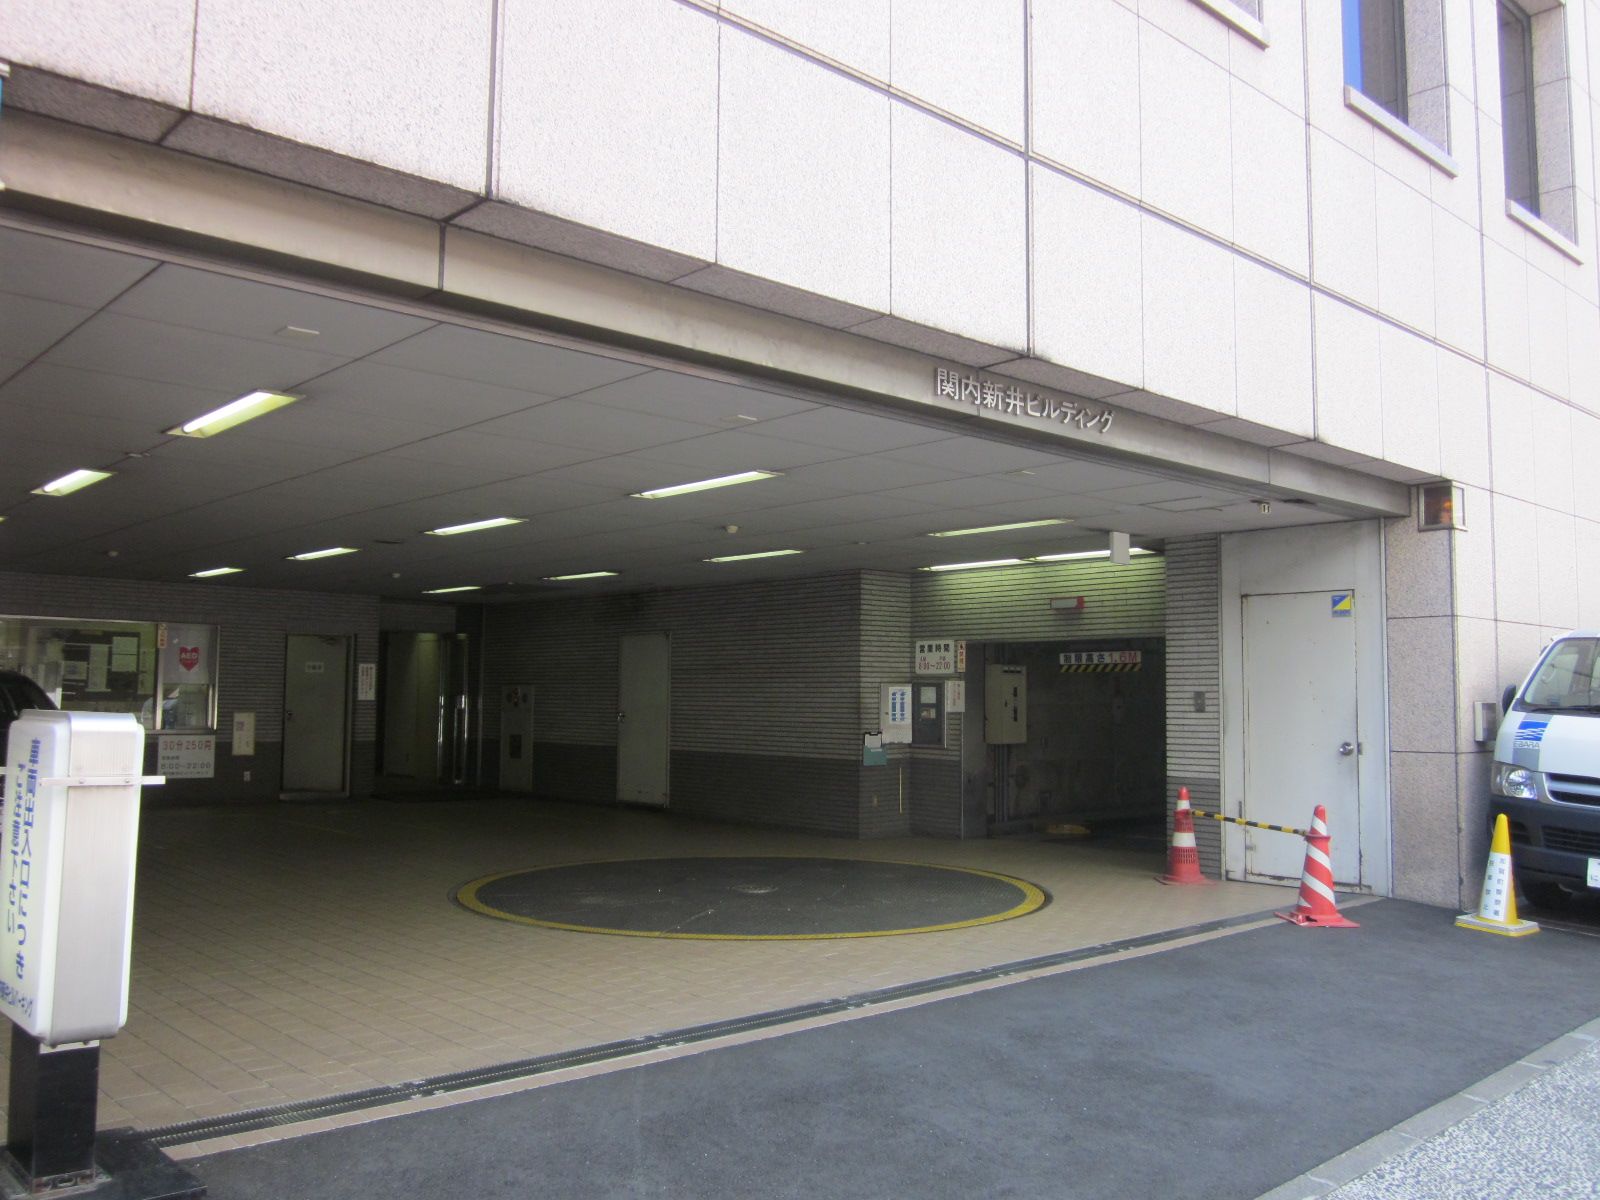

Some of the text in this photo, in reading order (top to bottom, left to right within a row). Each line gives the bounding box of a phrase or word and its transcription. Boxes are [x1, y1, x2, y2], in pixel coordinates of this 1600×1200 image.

[936, 367, 1114, 433] 関内新井ビルディング
